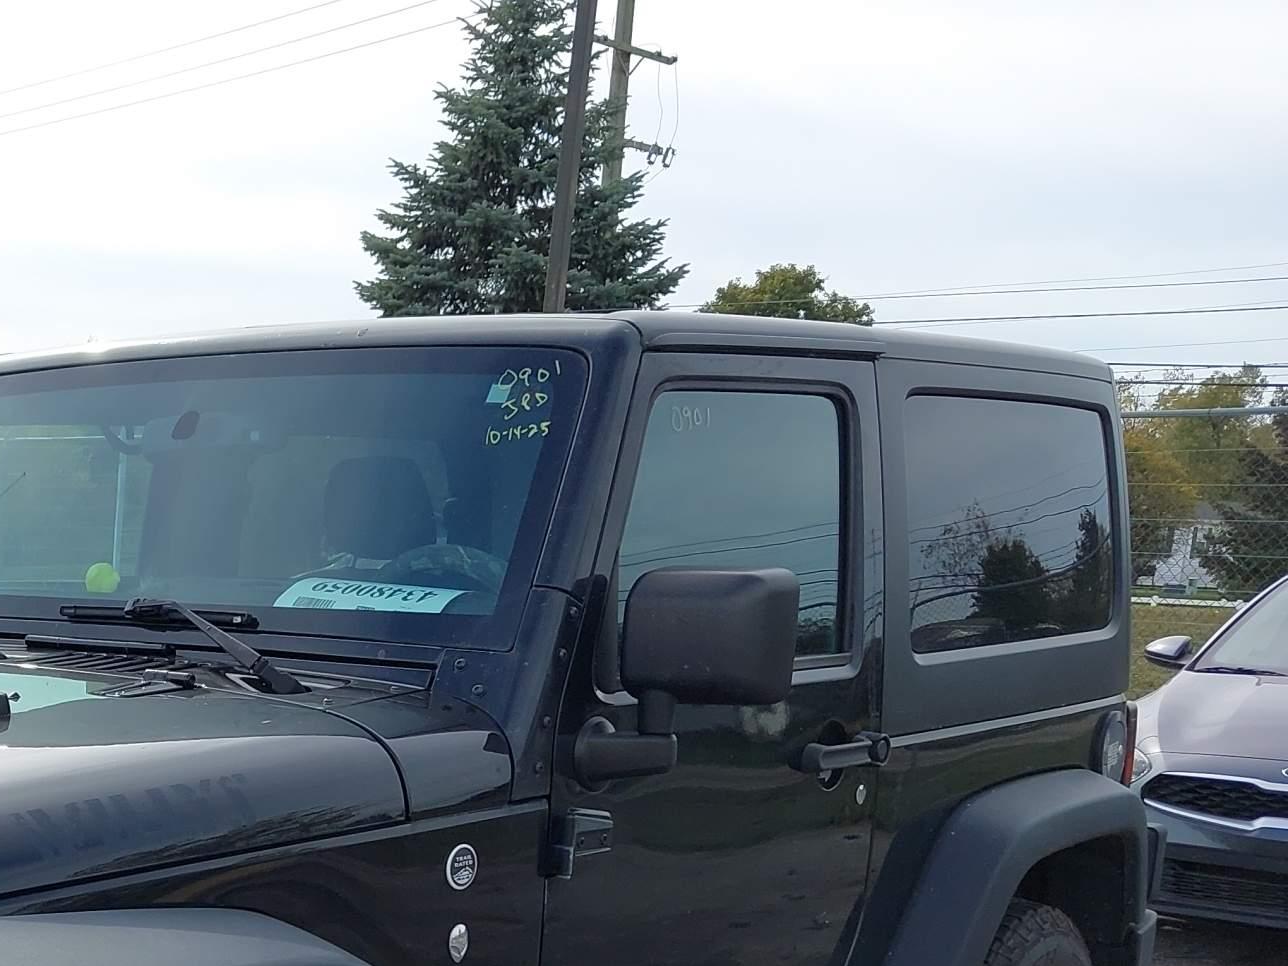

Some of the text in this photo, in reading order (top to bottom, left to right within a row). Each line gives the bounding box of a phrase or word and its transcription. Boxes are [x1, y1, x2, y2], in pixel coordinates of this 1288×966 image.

[497, 360, 561, 389] 0901
[671, 405, 711, 432] 0901
[485, 421, 552, 445] 10-14-25
[311, 580, 439, 604] 43480059
[454, 859, 474, 868] RATED
[455, 854, 473, 862] TRAIL
